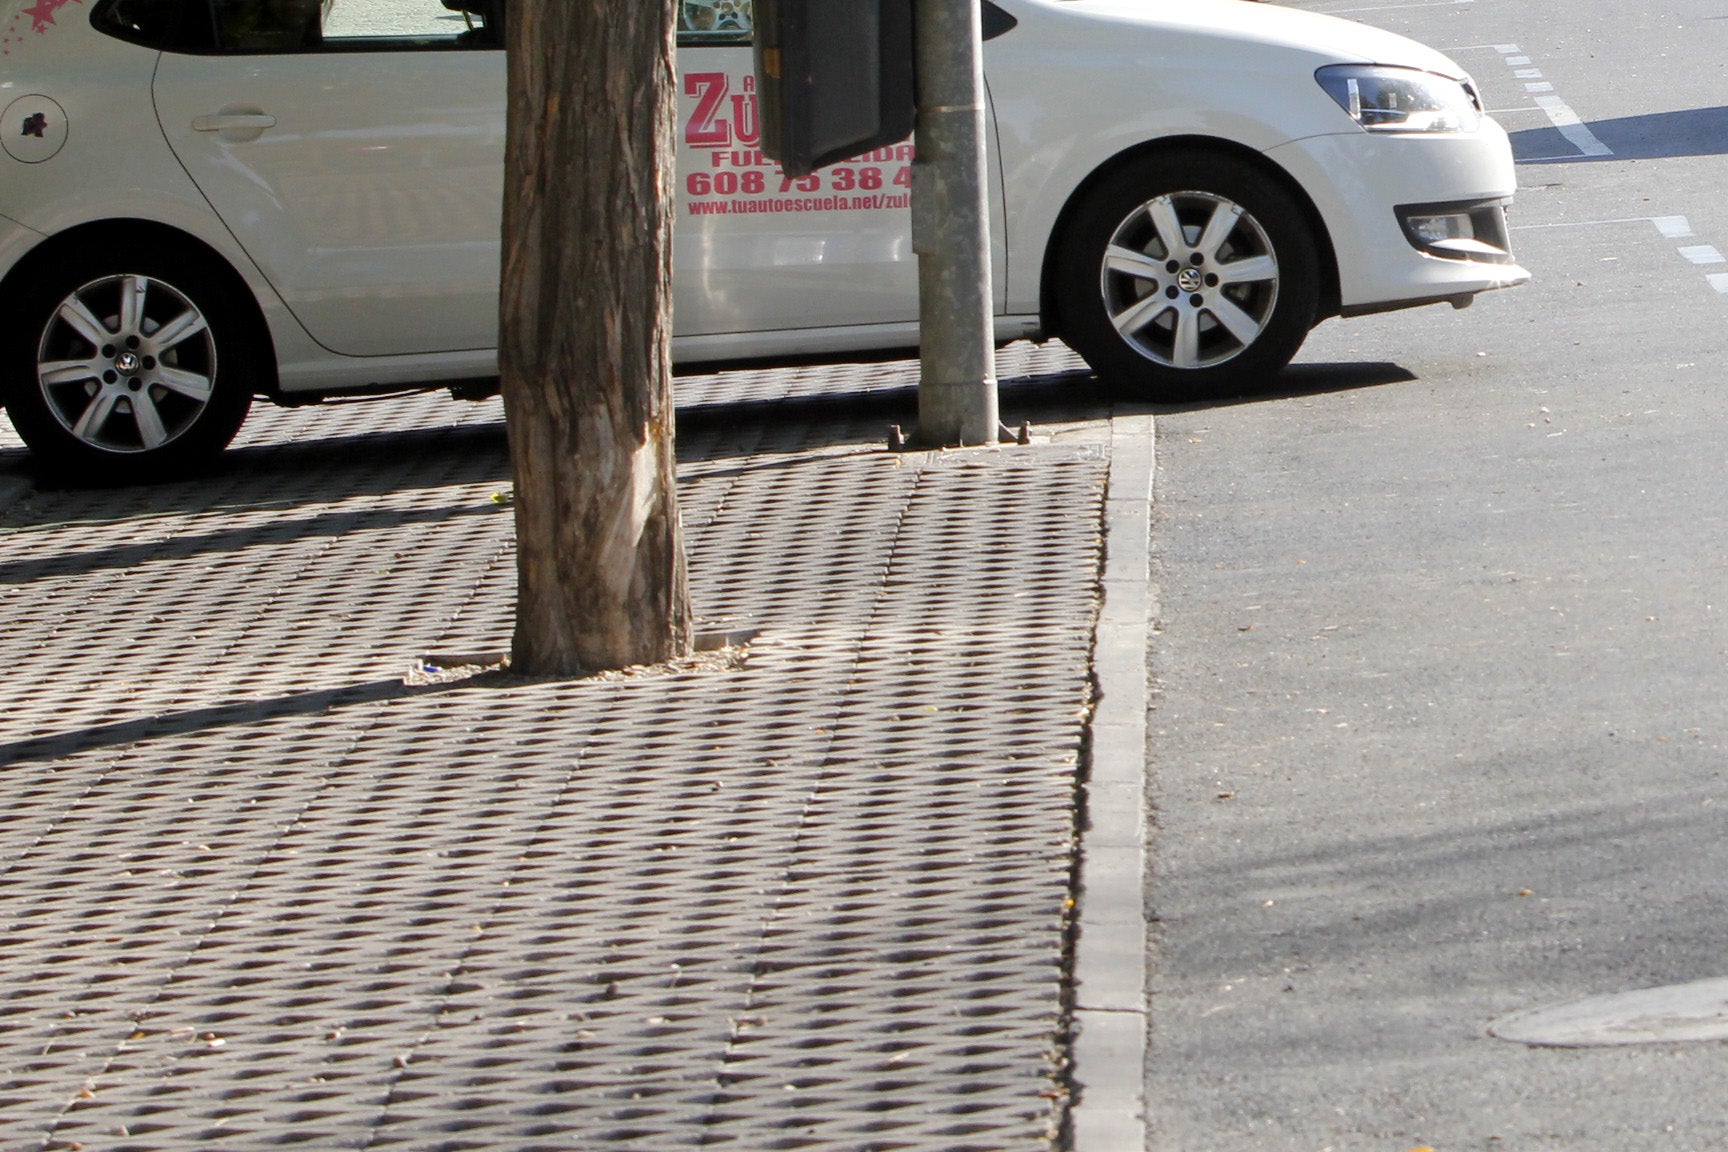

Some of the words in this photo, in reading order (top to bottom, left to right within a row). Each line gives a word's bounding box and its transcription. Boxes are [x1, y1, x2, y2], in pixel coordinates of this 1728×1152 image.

[686, 170, 765, 195] 608
[832, 167, 883, 191] 38
[688, 192, 912, 216] www.tuautoescuela.net/zul
